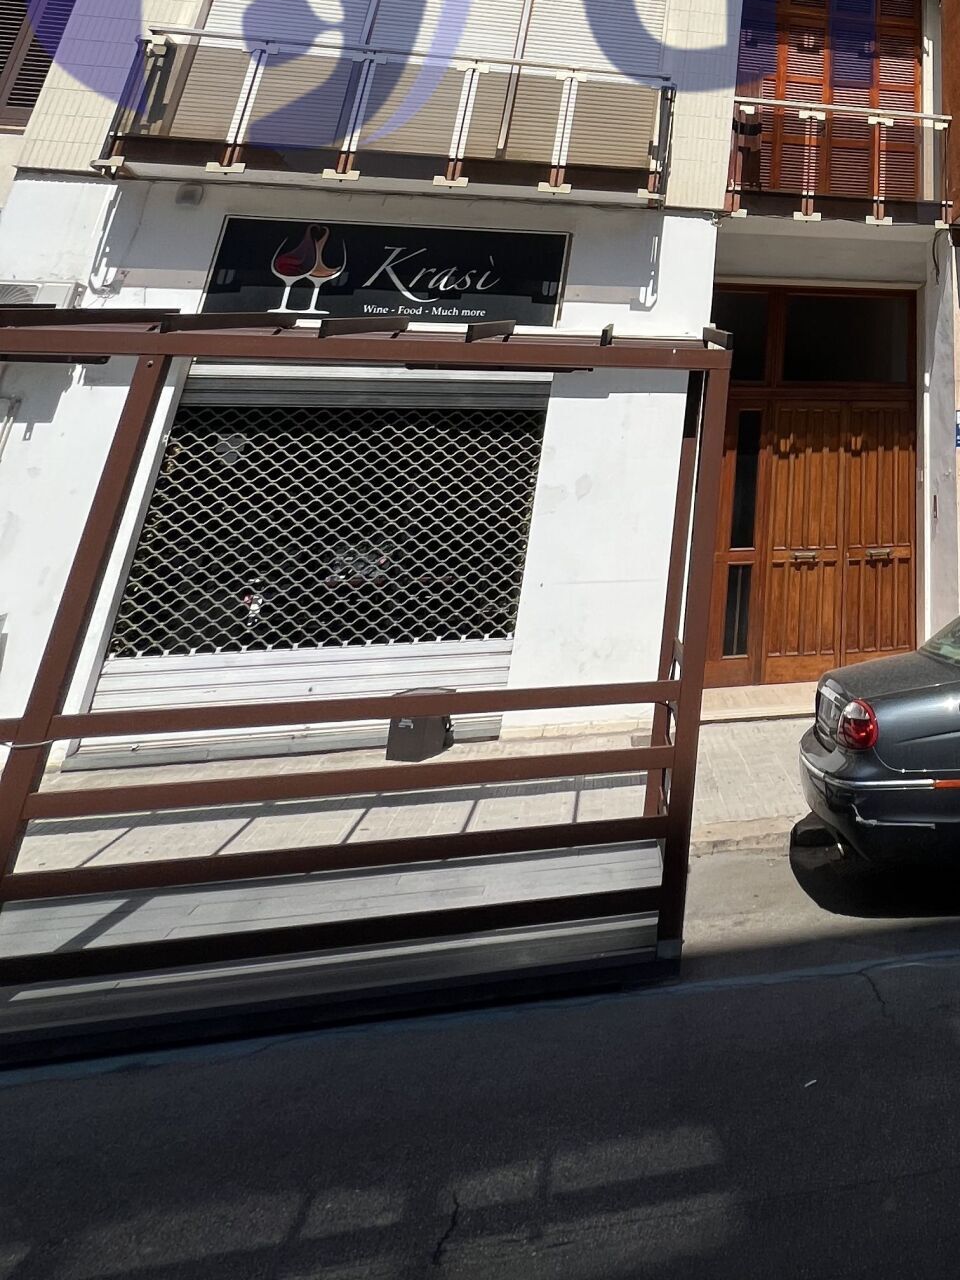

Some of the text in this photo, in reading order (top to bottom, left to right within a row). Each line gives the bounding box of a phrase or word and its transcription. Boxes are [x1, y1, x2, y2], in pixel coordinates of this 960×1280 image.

[362, 245, 500, 302] Krasì
[363, 304, 388, 314] Wine
[398, 305, 422, 315] Food
[431, 307, 458, 316] Much
[461, 309, 486, 317] more
